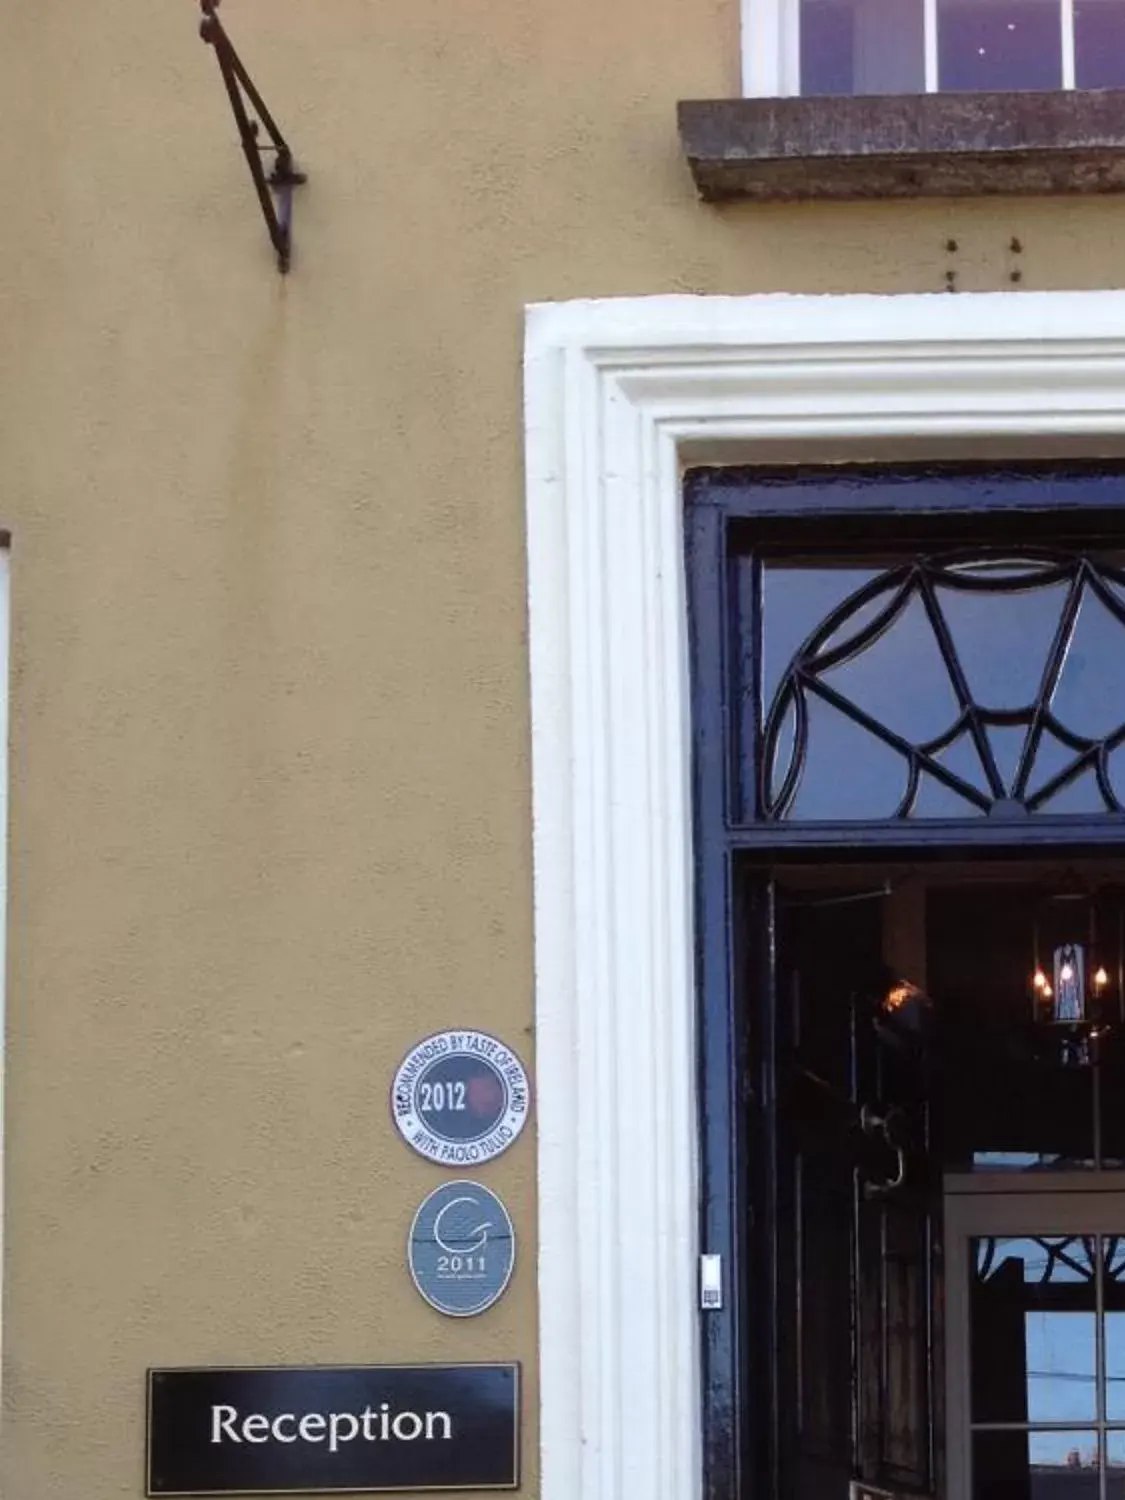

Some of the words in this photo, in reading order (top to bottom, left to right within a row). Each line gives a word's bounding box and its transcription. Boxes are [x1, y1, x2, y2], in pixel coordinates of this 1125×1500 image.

[450, 1035, 464, 1050] BY
[466, 1035, 498, 1056] TASTE
[495, 1051, 513, 1066] OF
[396, 1037, 448, 1117] RECOMMENDED
[503, 1065, 526, 1113] IRELAND
[421, 1081, 466, 1111] 2012
[412, 1129, 440, 1156] WITH
[440, 1143, 480, 1161] PAOLO
[479, 1125, 514, 1156] TULLIO
[437, 1255, 486, 1271] 2011
[210, 1402, 452, 1451] Reception
